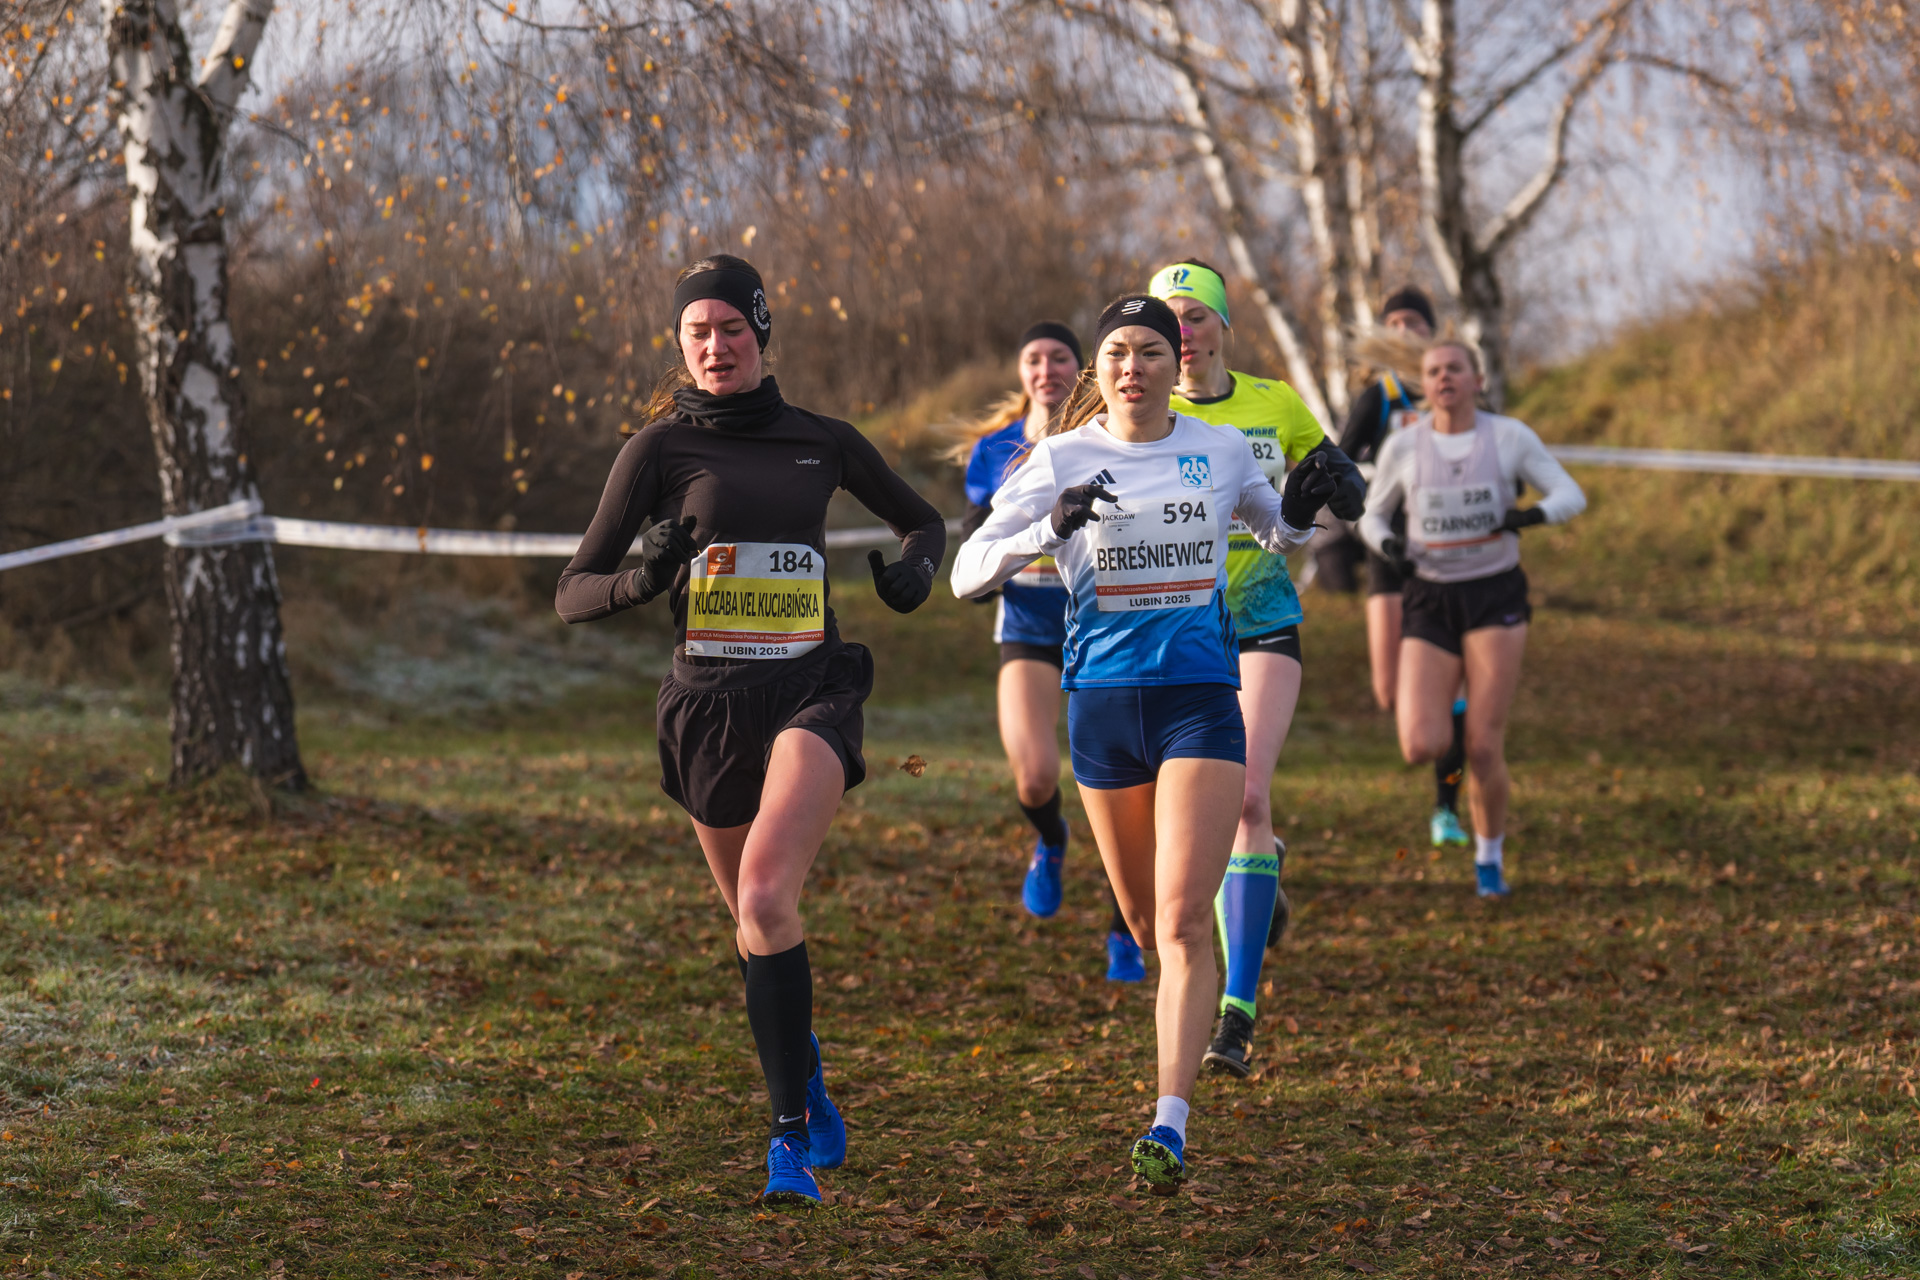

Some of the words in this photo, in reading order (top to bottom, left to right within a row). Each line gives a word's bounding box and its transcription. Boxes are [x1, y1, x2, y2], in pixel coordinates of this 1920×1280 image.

[1102, 513, 1136, 524] JACKDAW
[1163, 501, 1207, 524] 594
[769, 551, 813, 573] 184
[1097, 540, 1214, 571] BEREŚNIEWICZ
[695, 591, 738, 616] KUCZABA
[740, 592, 756, 617] VEL
[758, 588, 820, 618] KUCIABIŃSKA
[1129, 597, 1162, 607] LUBIN
[1164, 595, 1191, 605] 2025
[723, 646, 757, 656] LUBIN
[759, 646, 789, 656] 2025
